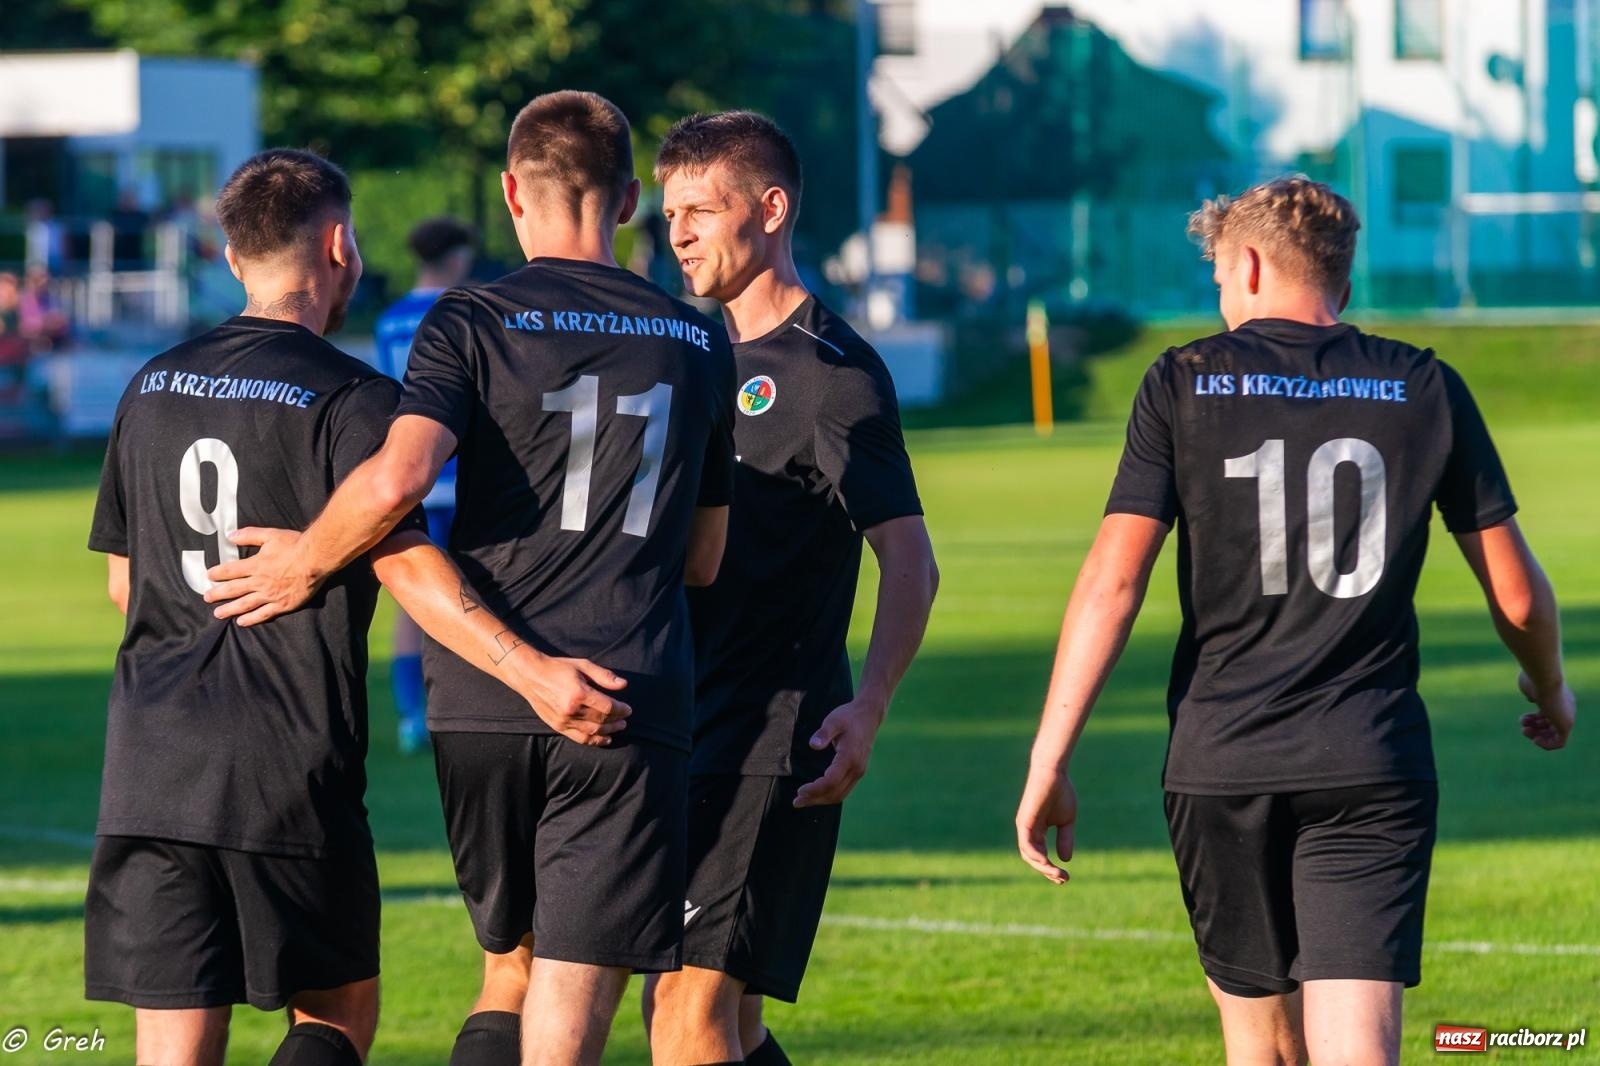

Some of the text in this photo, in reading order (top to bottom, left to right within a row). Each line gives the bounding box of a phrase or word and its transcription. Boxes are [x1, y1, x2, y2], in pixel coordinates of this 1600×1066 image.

[504, 311, 711, 352] LKS KRZYŻANOWICE
[140, 370, 316, 408] LKS KRZYŻANOWICE
[1195, 374, 1408, 402] LKS KRZYŻANOWICE
[541, 374, 673, 538] 11
[179, 437, 241, 597] 9
[1223, 437, 1387, 599] 10
